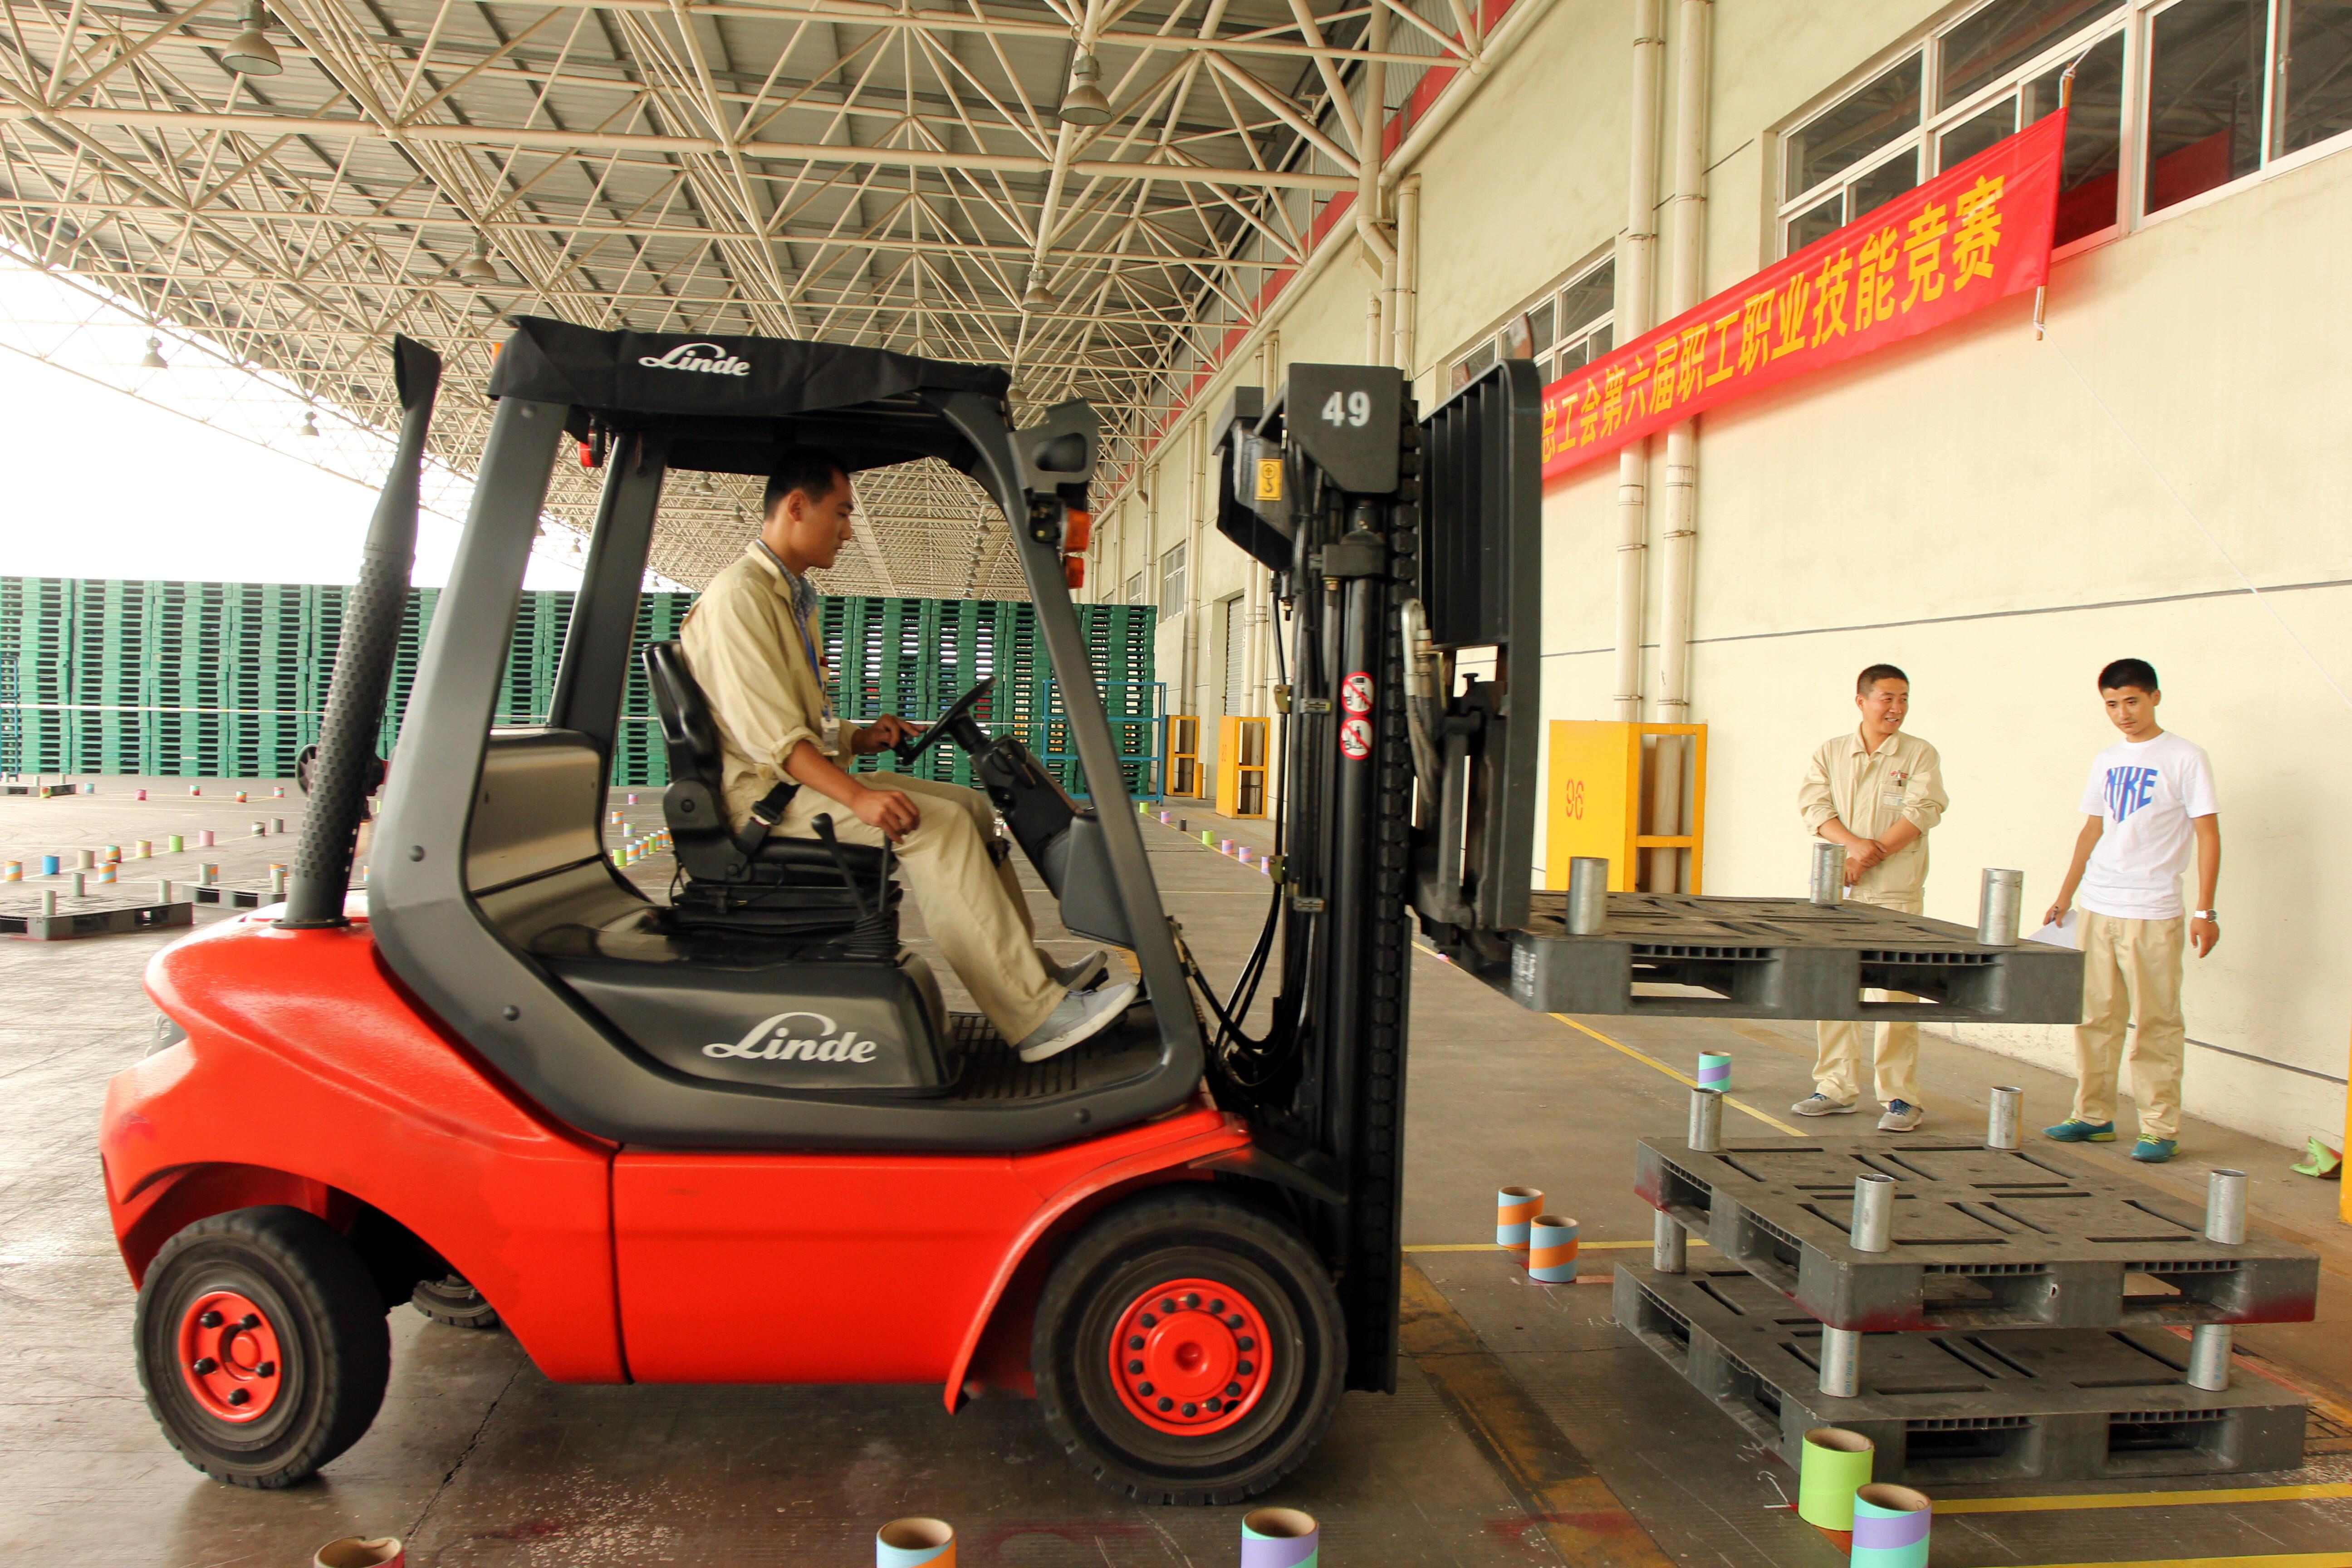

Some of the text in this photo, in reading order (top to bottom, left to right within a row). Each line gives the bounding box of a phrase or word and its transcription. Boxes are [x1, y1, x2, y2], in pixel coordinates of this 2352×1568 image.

[1542, 175, 2004, 464] 总工会第六届职工职业技能竞赛
[638, 343, 751, 376] Linde
[1322, 391, 1370, 426] 49
[1566, 778, 1584, 820] 96
[2104, 766, 2159, 824] NIKE
[702, 1012, 877, 1063] Linde
